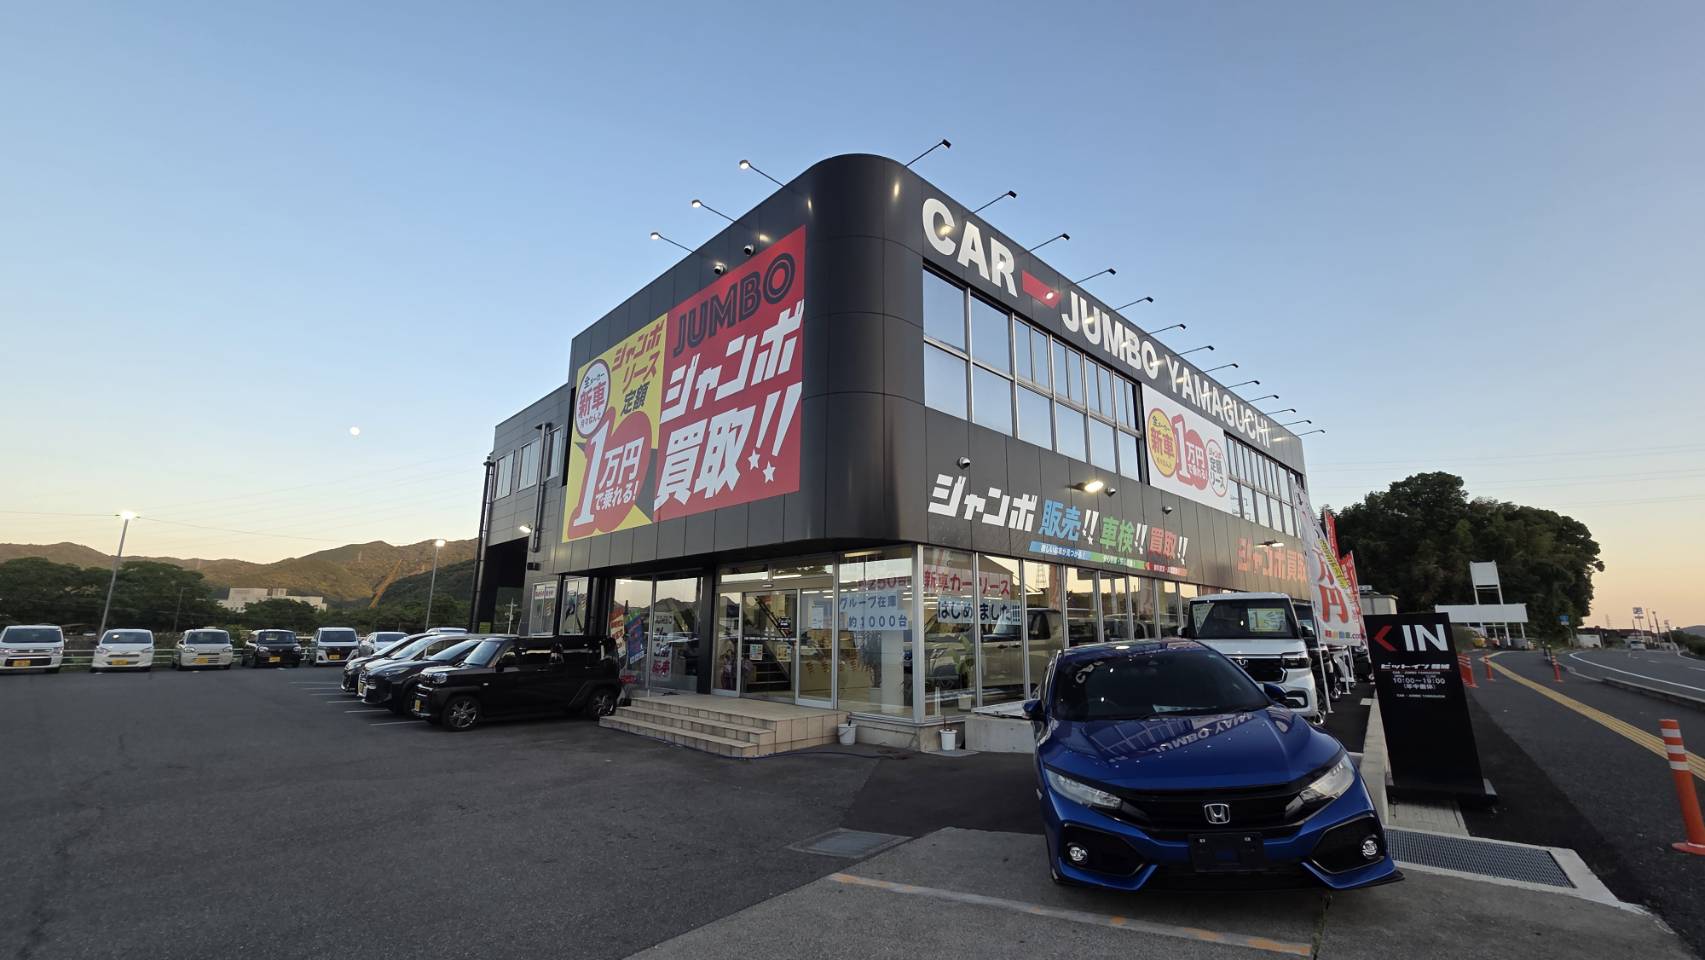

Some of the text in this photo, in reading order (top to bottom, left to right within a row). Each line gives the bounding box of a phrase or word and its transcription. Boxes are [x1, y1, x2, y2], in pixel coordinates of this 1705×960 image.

[673, 252, 796, 356] JUMBO
[922, 198, 1270, 447] CAR JUMBO YAMAGUCHI
[612, 319, 664, 372] ジャンボ
[660, 299, 804, 423] ジャンボ
[623, 351, 660, 393] リース
[579, 381, 606, 418] 新車
[621, 381, 650, 416] 定額
[1151, 427, 1175, 460] 新車
[928, 473, 1037, 532] ジャンボ
[1402, 624, 1449, 652] IN
